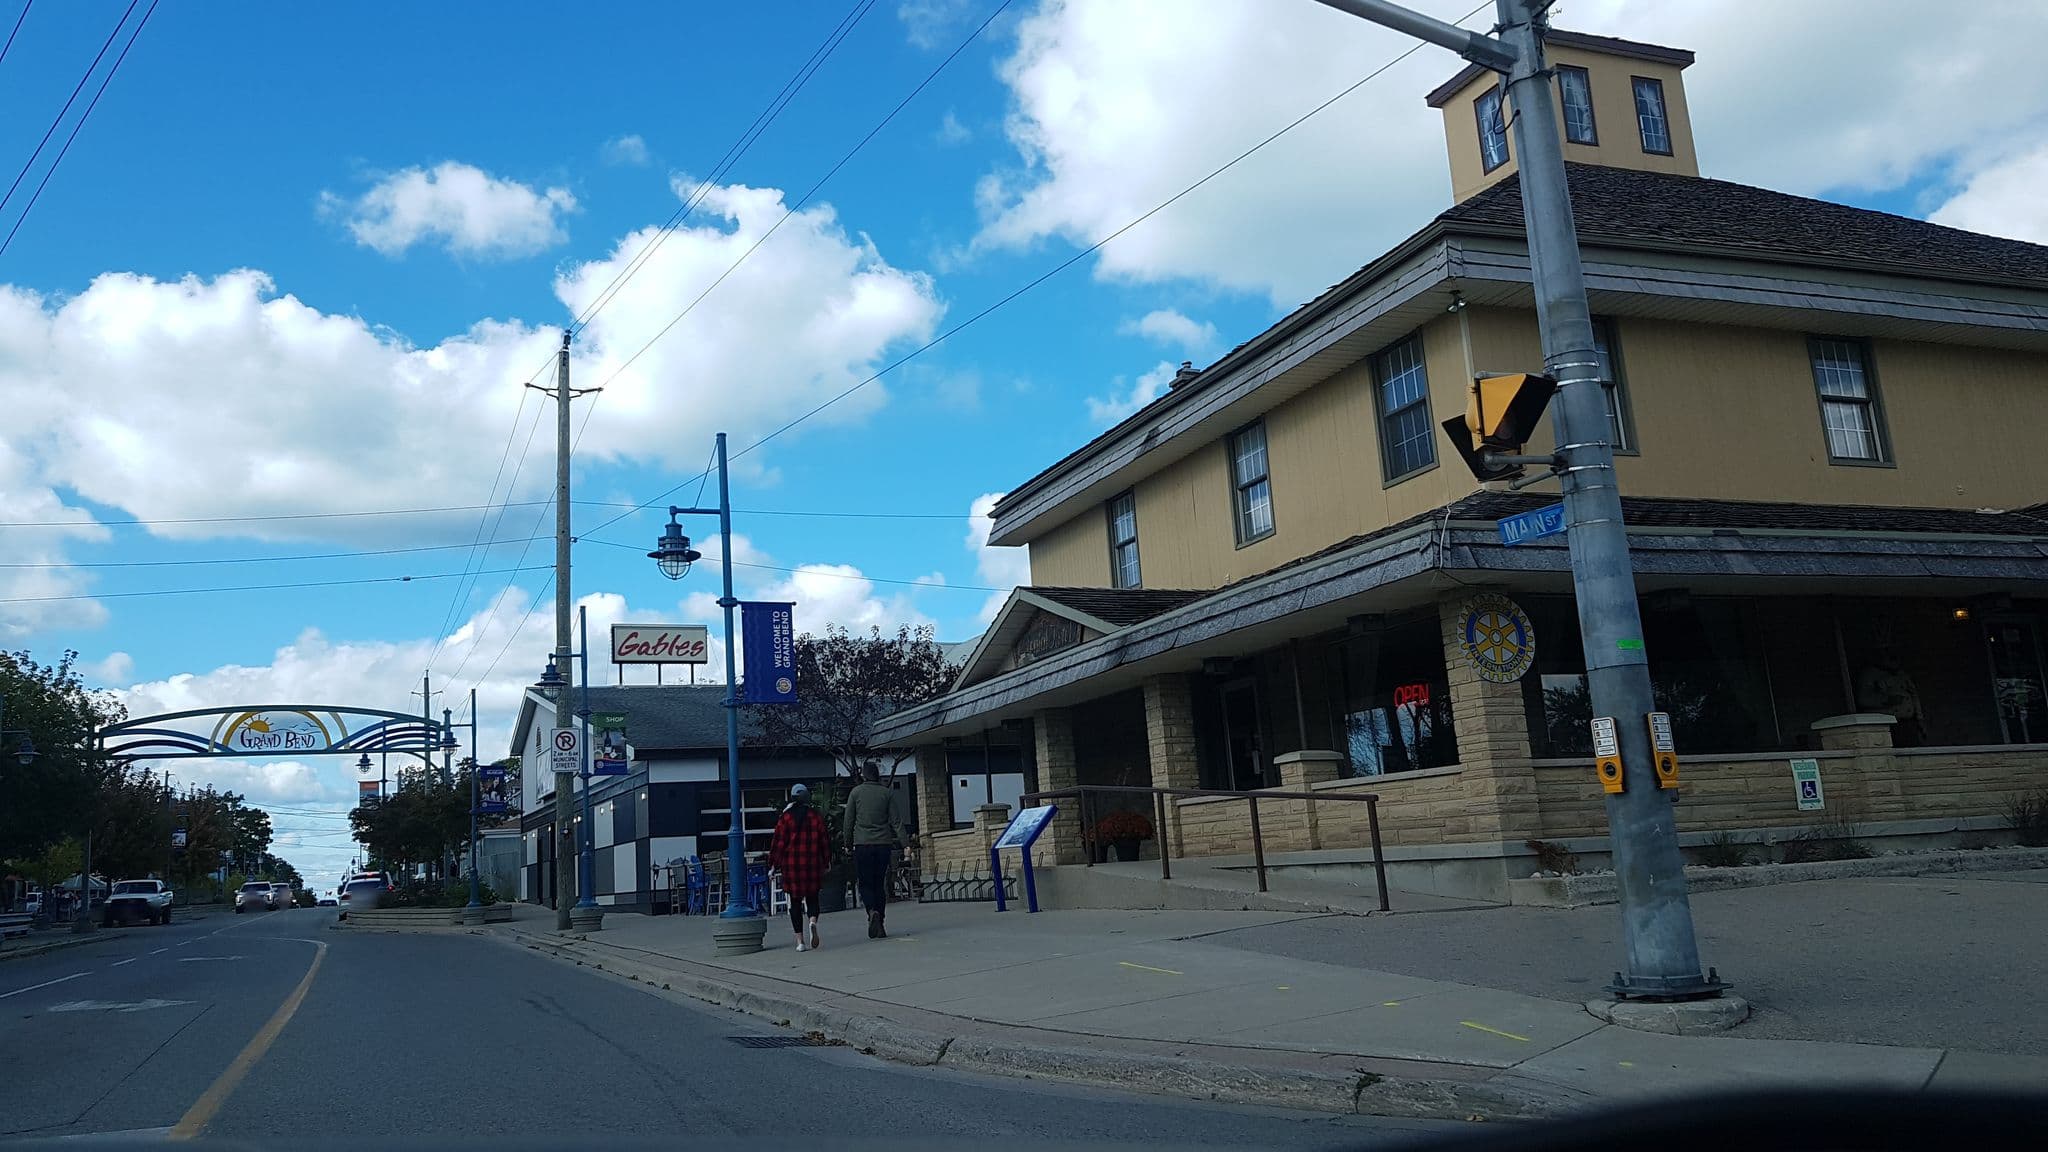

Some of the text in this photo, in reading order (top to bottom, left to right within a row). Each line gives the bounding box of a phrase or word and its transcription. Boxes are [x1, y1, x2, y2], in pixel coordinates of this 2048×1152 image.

[618, 632, 705, 656] Gables
[773, 611, 782, 669] WELCOME TO
[781, 611, 791, 669] GRAND BEND
[1394, 684, 1428, 707] OPEN
[240, 728, 316, 749] GRAND BEND
